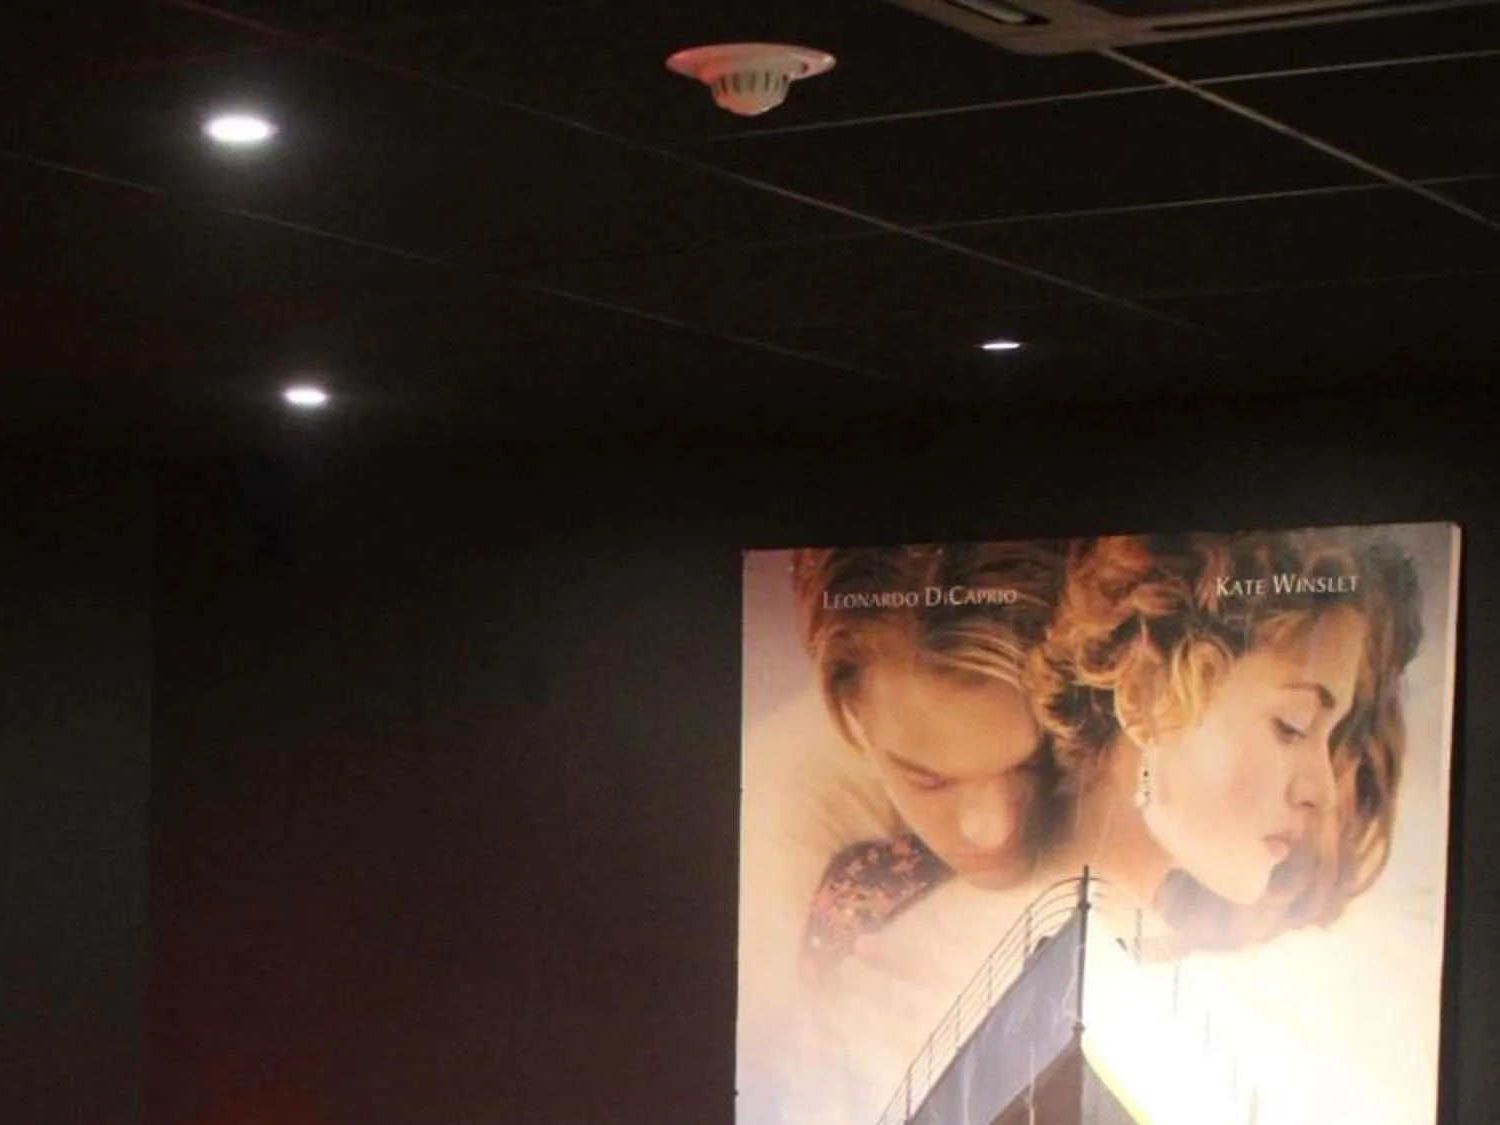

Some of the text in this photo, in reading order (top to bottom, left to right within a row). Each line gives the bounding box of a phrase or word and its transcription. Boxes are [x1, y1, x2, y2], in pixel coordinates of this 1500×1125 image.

[1216, 574, 1359, 596] KATE WINSLET
[823, 591, 919, 609] LEONARDO
